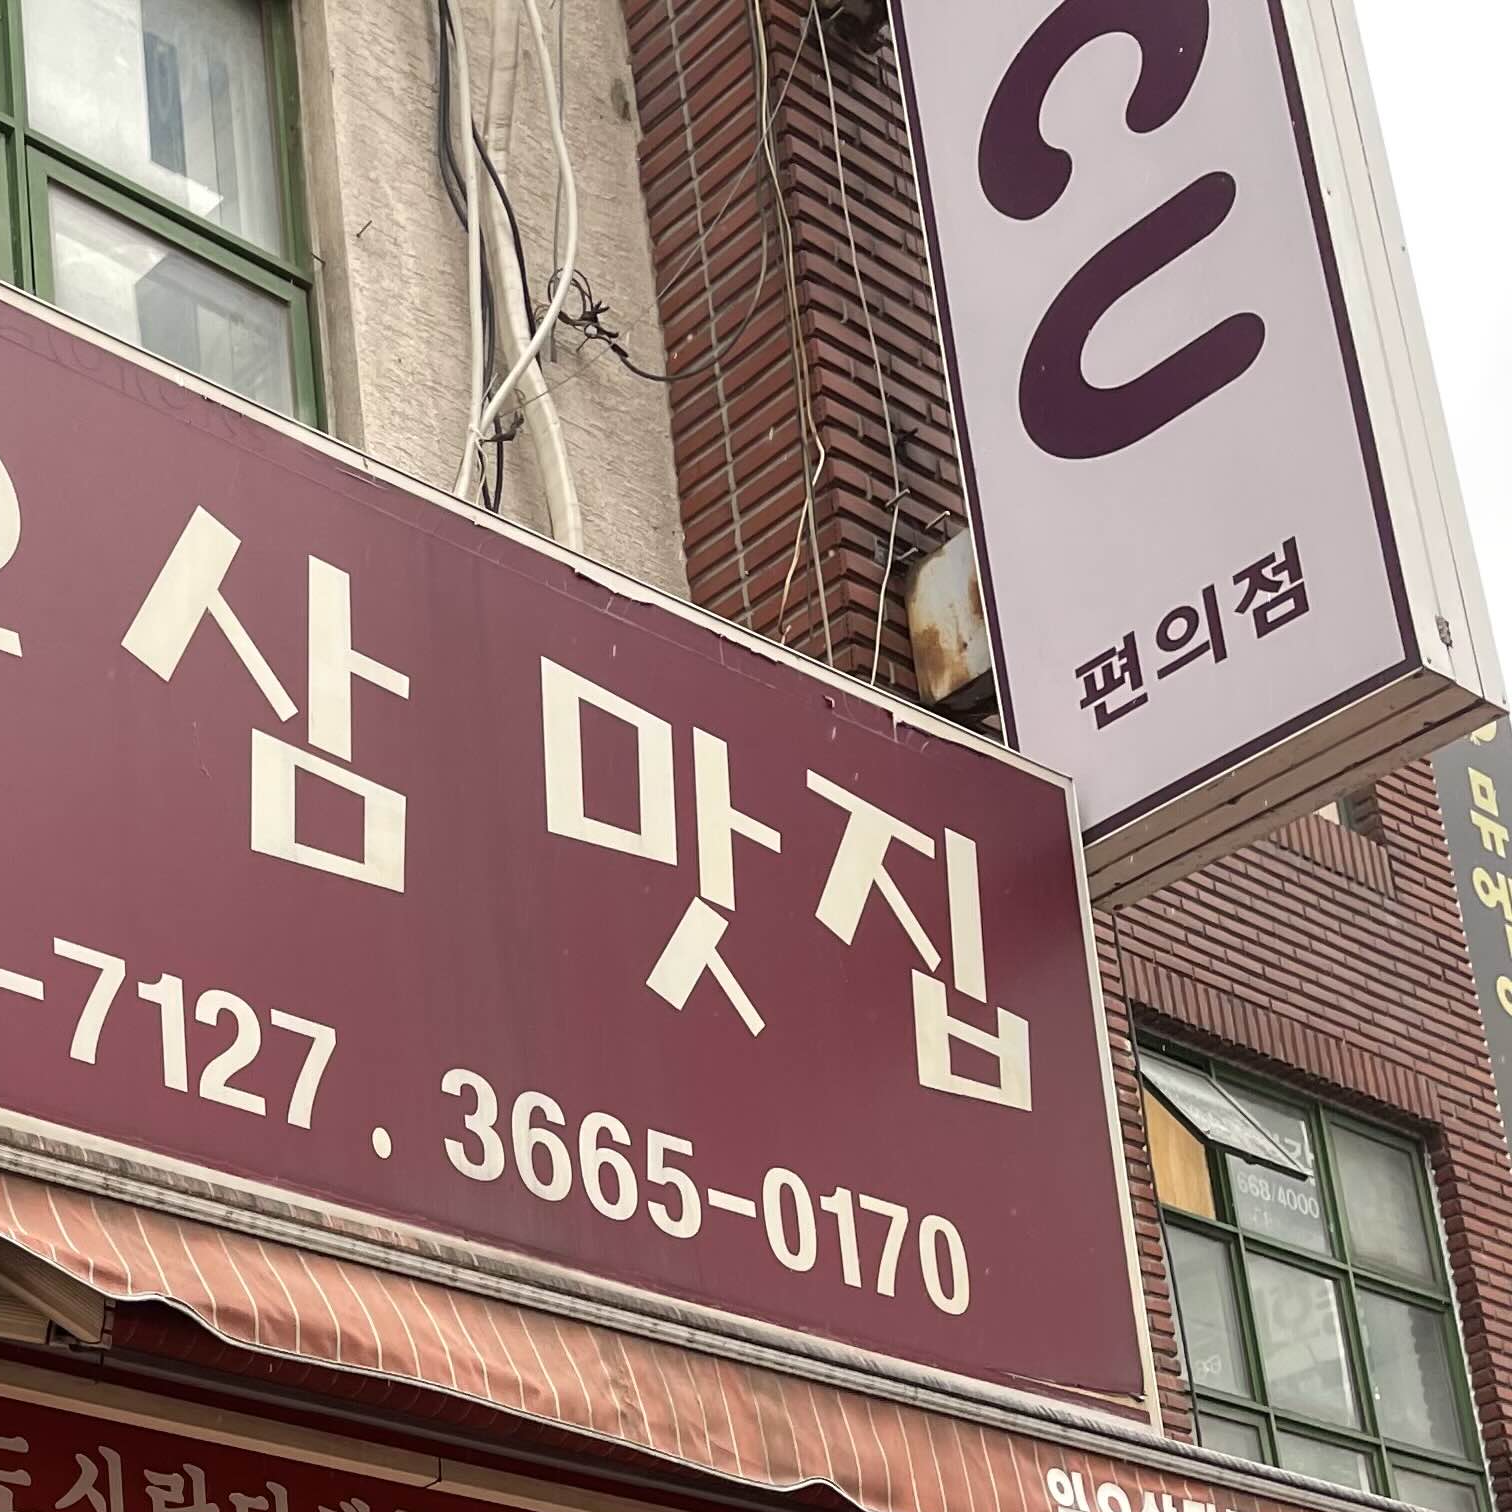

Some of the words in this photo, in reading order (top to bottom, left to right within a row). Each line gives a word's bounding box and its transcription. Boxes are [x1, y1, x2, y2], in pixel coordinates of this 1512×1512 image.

[977, 0, 1266, 460] CU
[1074, 535, 1311, 731] 편의점
[441, 1067, 971, 1317] 3665-0170
